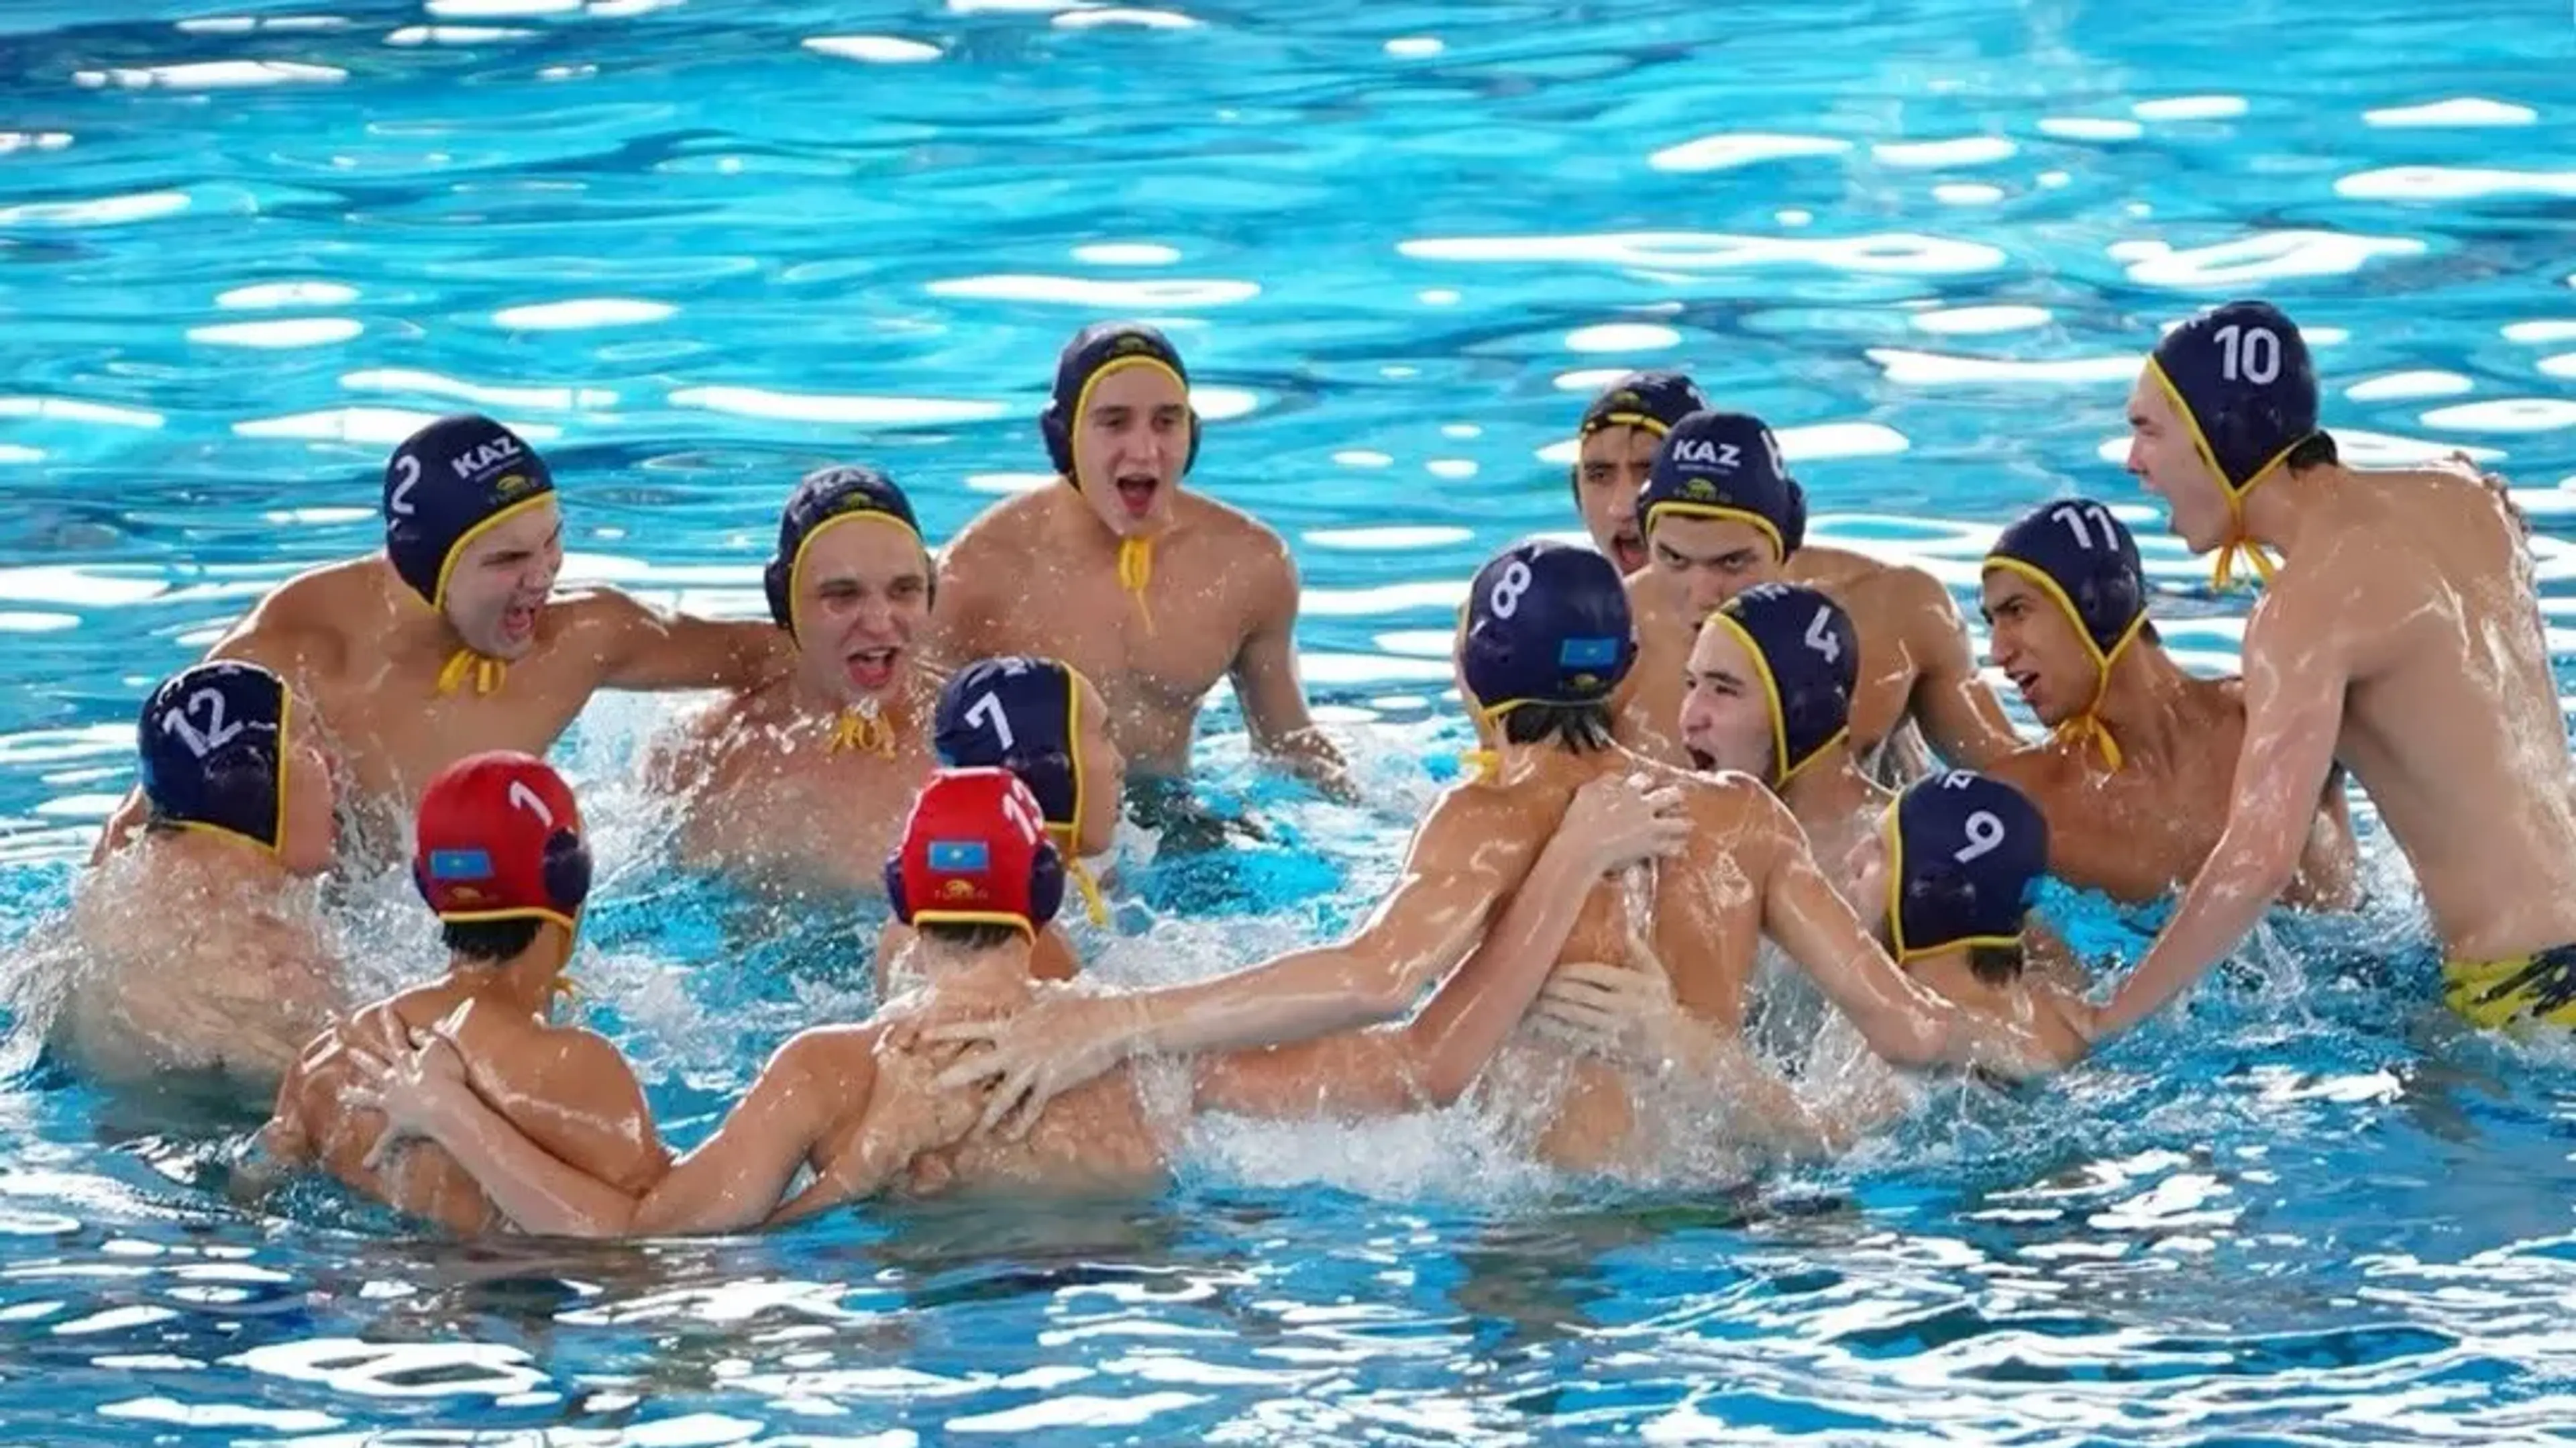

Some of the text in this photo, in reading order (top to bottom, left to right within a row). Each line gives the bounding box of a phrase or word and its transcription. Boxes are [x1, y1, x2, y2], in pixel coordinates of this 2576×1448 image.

[2214, 325, 2280, 384] 10
[451, 435, 521, 479] KAZ
[1673, 439, 1741, 467] KAZ
[390, 454, 421, 515] 2
[2051, 506, 2119, 552] 11
[1491, 560, 1532, 619] 8
[1805, 605, 1840, 664] 4
[162, 687, 244, 758] 12
[964, 690, 1014, 750] 7
[509, 780, 553, 828] 1
[1953, 811, 2005, 863] 9
